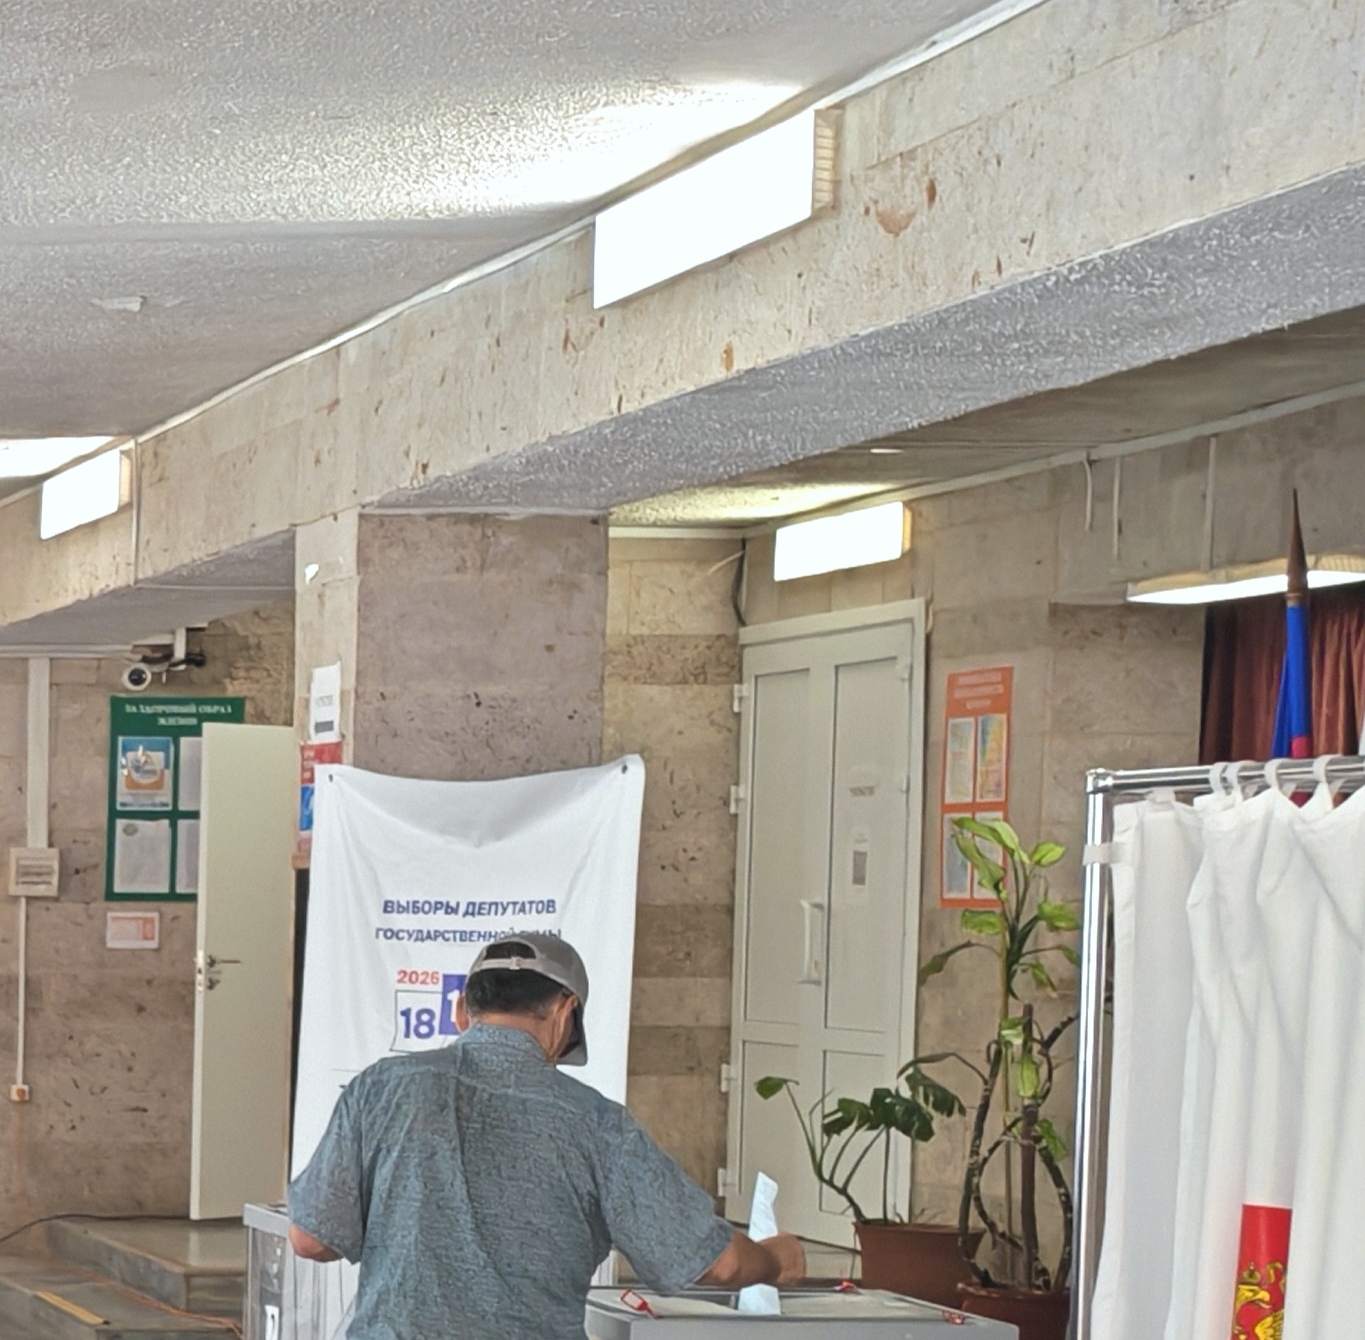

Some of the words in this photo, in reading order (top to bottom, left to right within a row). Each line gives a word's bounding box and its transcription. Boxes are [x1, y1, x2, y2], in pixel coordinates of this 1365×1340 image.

[383, 900, 460, 916] ВЫБОРЫ
[462, 898, 557, 918] ДЕПУТАТОВ
[396, 969, 440, 985] 2026
[399, 1007, 436, 1039] 18
[447, 989, 462, 1023] 1
